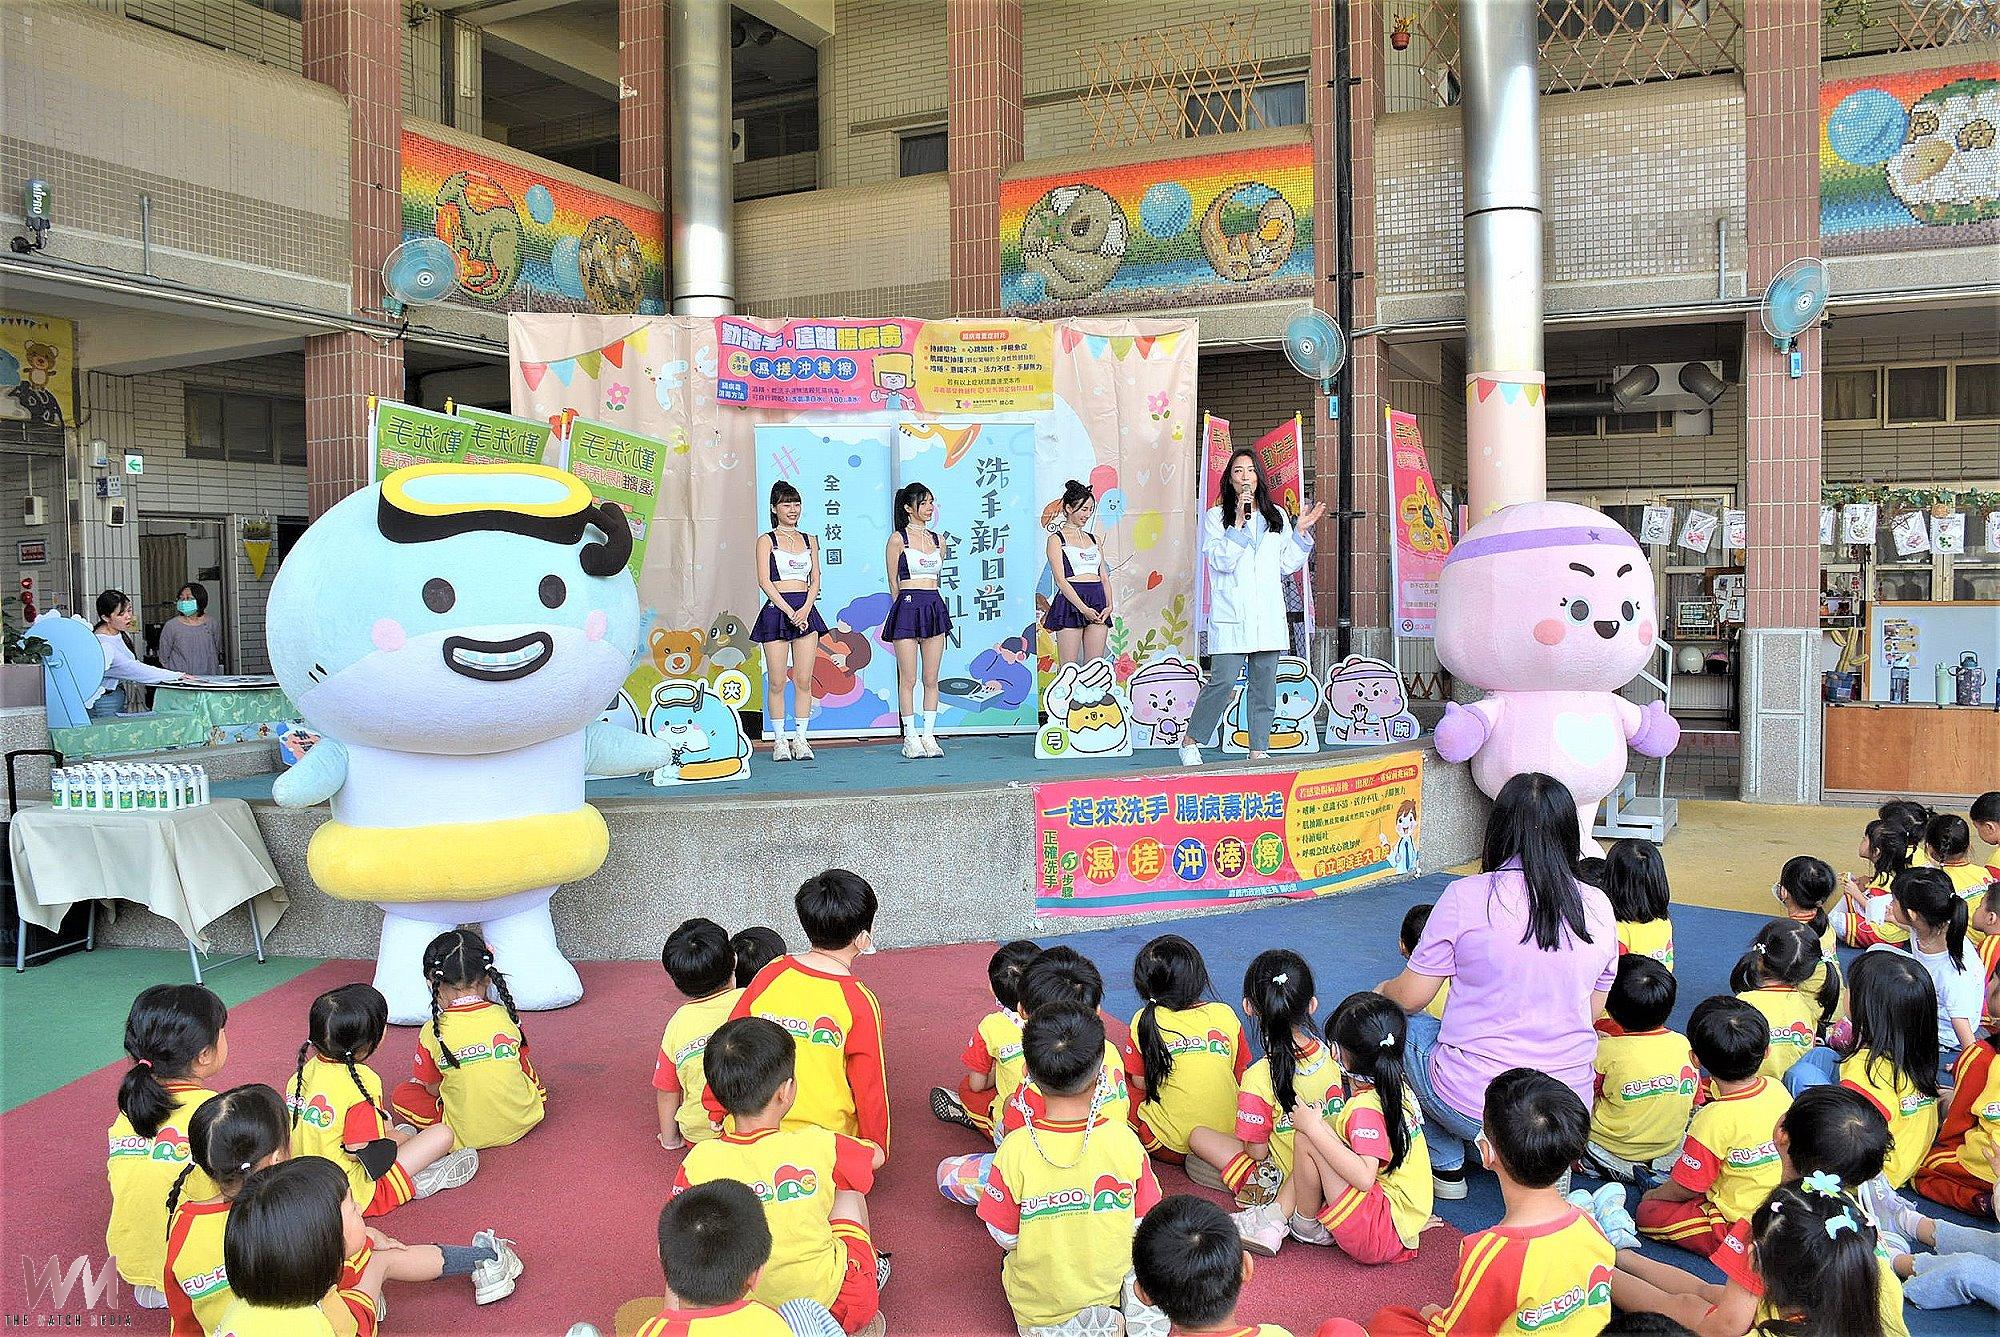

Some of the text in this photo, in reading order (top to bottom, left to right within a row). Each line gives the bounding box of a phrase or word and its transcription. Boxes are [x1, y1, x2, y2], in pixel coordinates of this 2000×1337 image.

[32, 183, 43, 215] MIPRO
[824, 475, 842, 565] 全台校園
[970, 456, 1011, 621] 洗手新日常
[722, 681, 742, 700] 夾
[1046, 733, 1062, 748] 弓
[1393, 721, 1411, 738] 腕
[1043, 792, 1286, 827] 一起來洗手 腸病毒快走
[1043, 830, 1058, 889] 正確洗手
[1624, 1076, 1673, 1094] FU-KOO
[183, 1268, 226, 1292] FU-K
